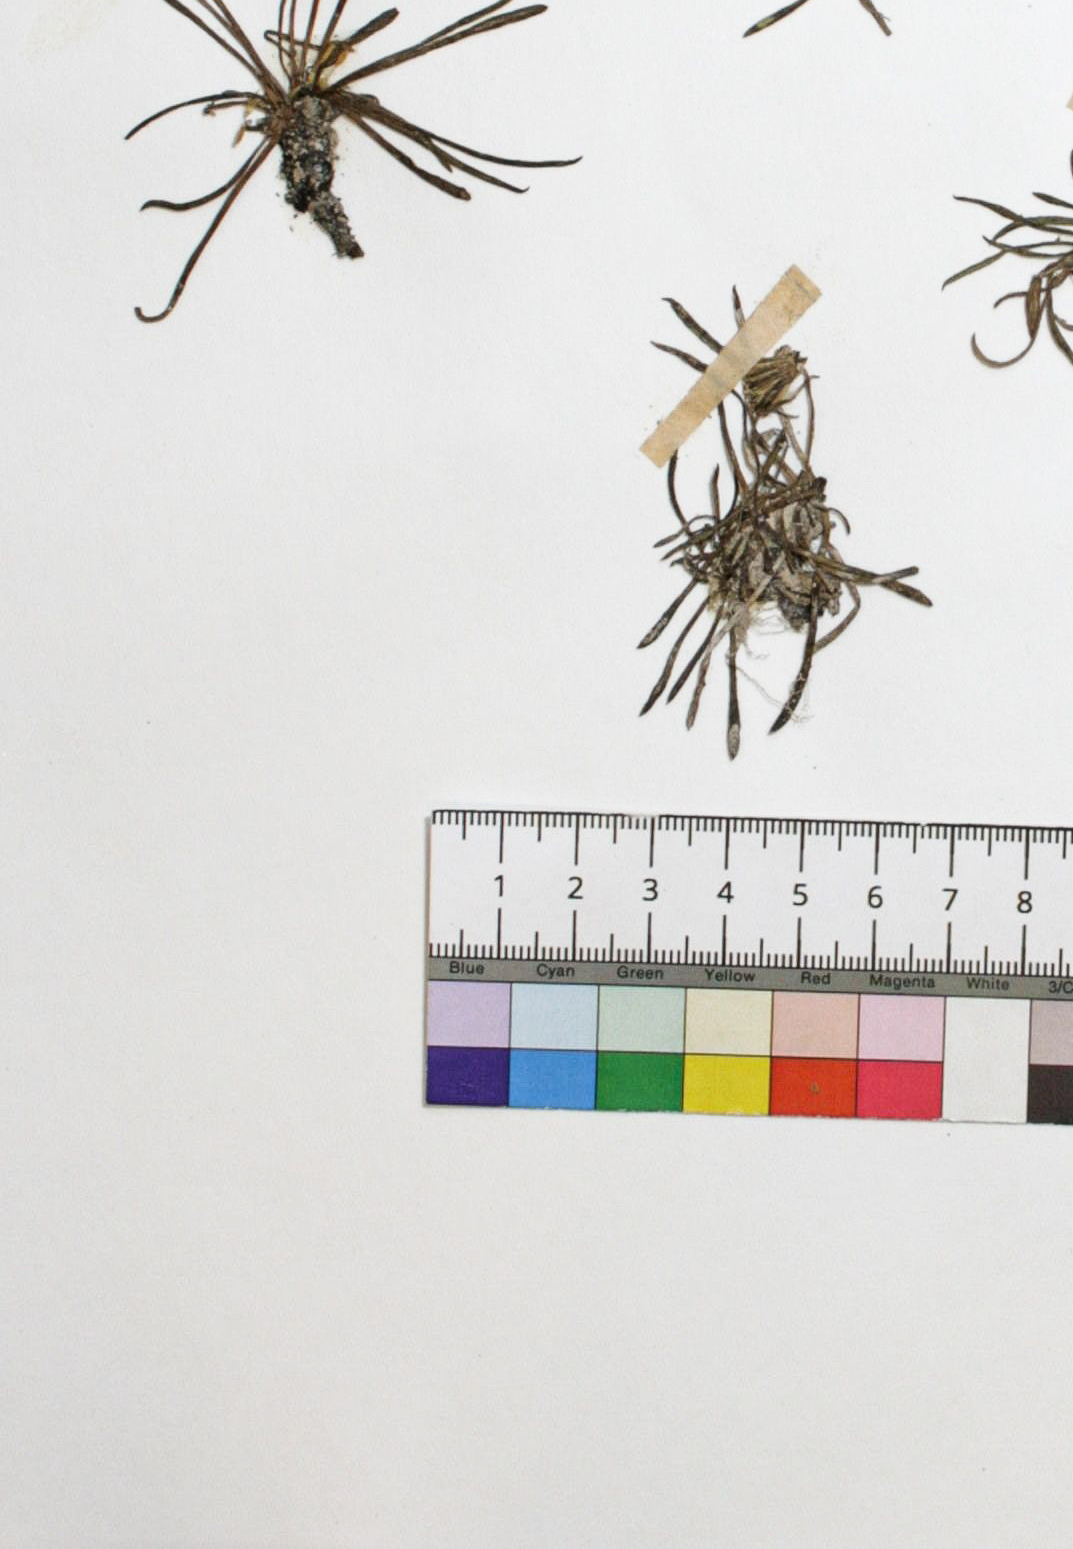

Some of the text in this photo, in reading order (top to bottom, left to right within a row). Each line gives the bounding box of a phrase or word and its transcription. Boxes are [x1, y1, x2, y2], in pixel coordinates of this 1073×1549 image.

[494, 875, 503, 897] 1
[567, 876, 584, 900] 2
[642, 878, 658, 902] 3
[717, 881, 734, 904] 4
[793, 883, 808, 906] 5
[867, 885, 883, 909] 6
[943, 888, 958, 911] 7
[1017, 891, 1033, 914] 8
[449, 961, 485, 975] Blue
[536, 964, 576, 979] Cyan
[616, 967, 664, 981] Green
[704, 968, 756, 983] Yellow
[801, 971, 831, 985] Red
[869, 974, 936, 990] Magenta
[966, 977, 1010, 991] White
